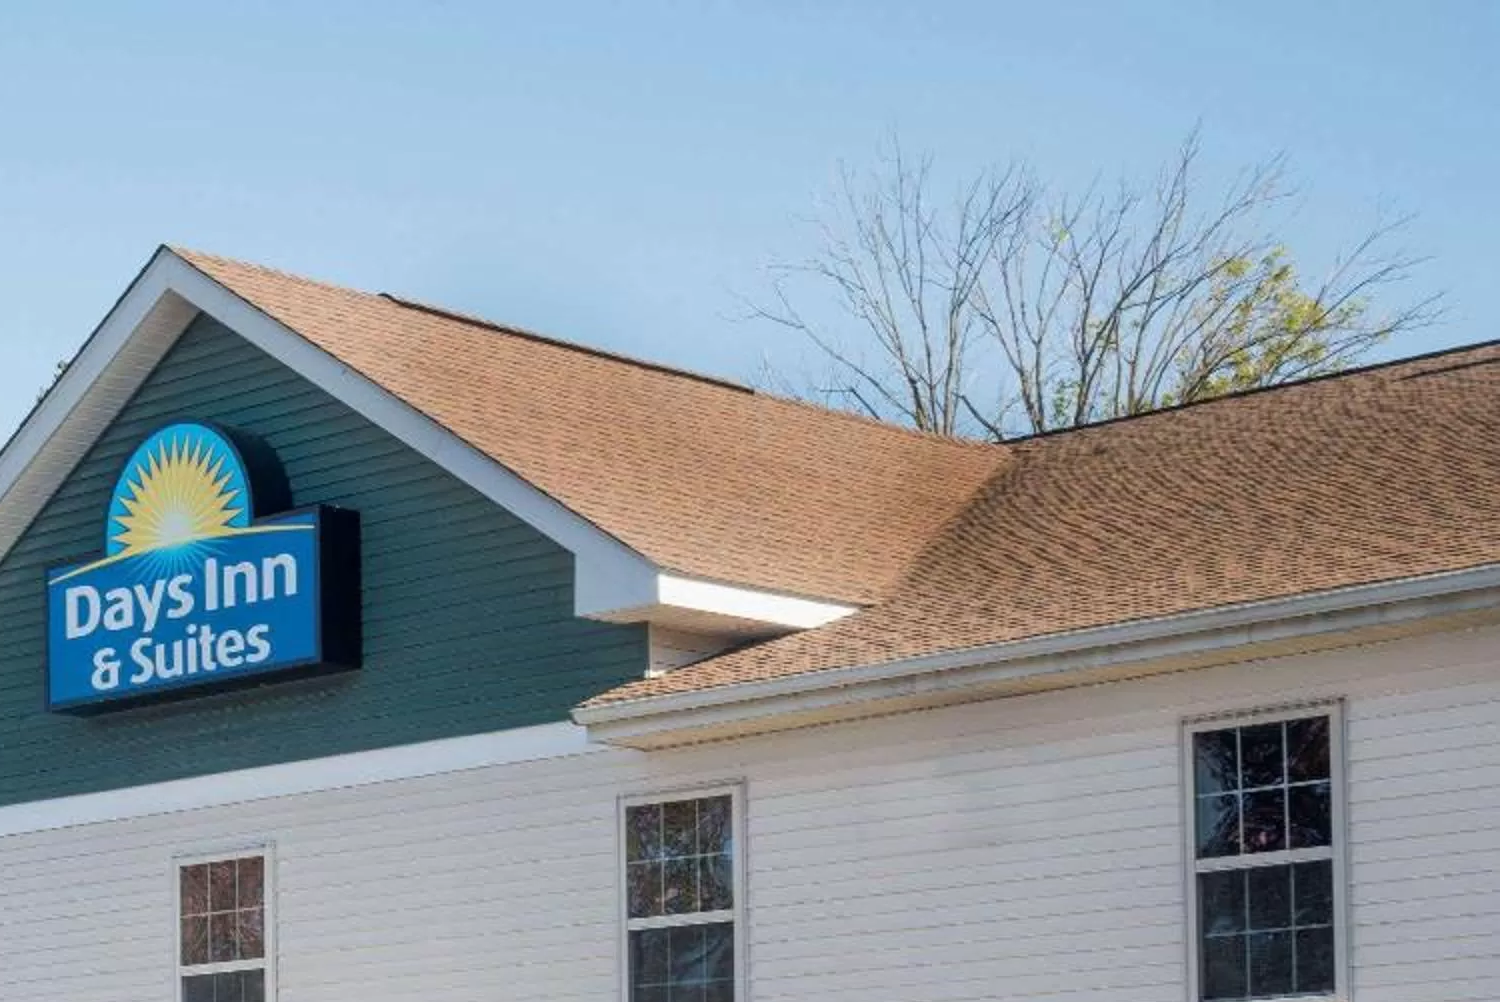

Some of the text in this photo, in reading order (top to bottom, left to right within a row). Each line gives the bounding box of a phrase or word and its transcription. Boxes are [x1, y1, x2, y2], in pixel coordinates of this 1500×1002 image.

[65, 552, 298, 640] Days Inn
[90, 623, 272, 691] & Suites
